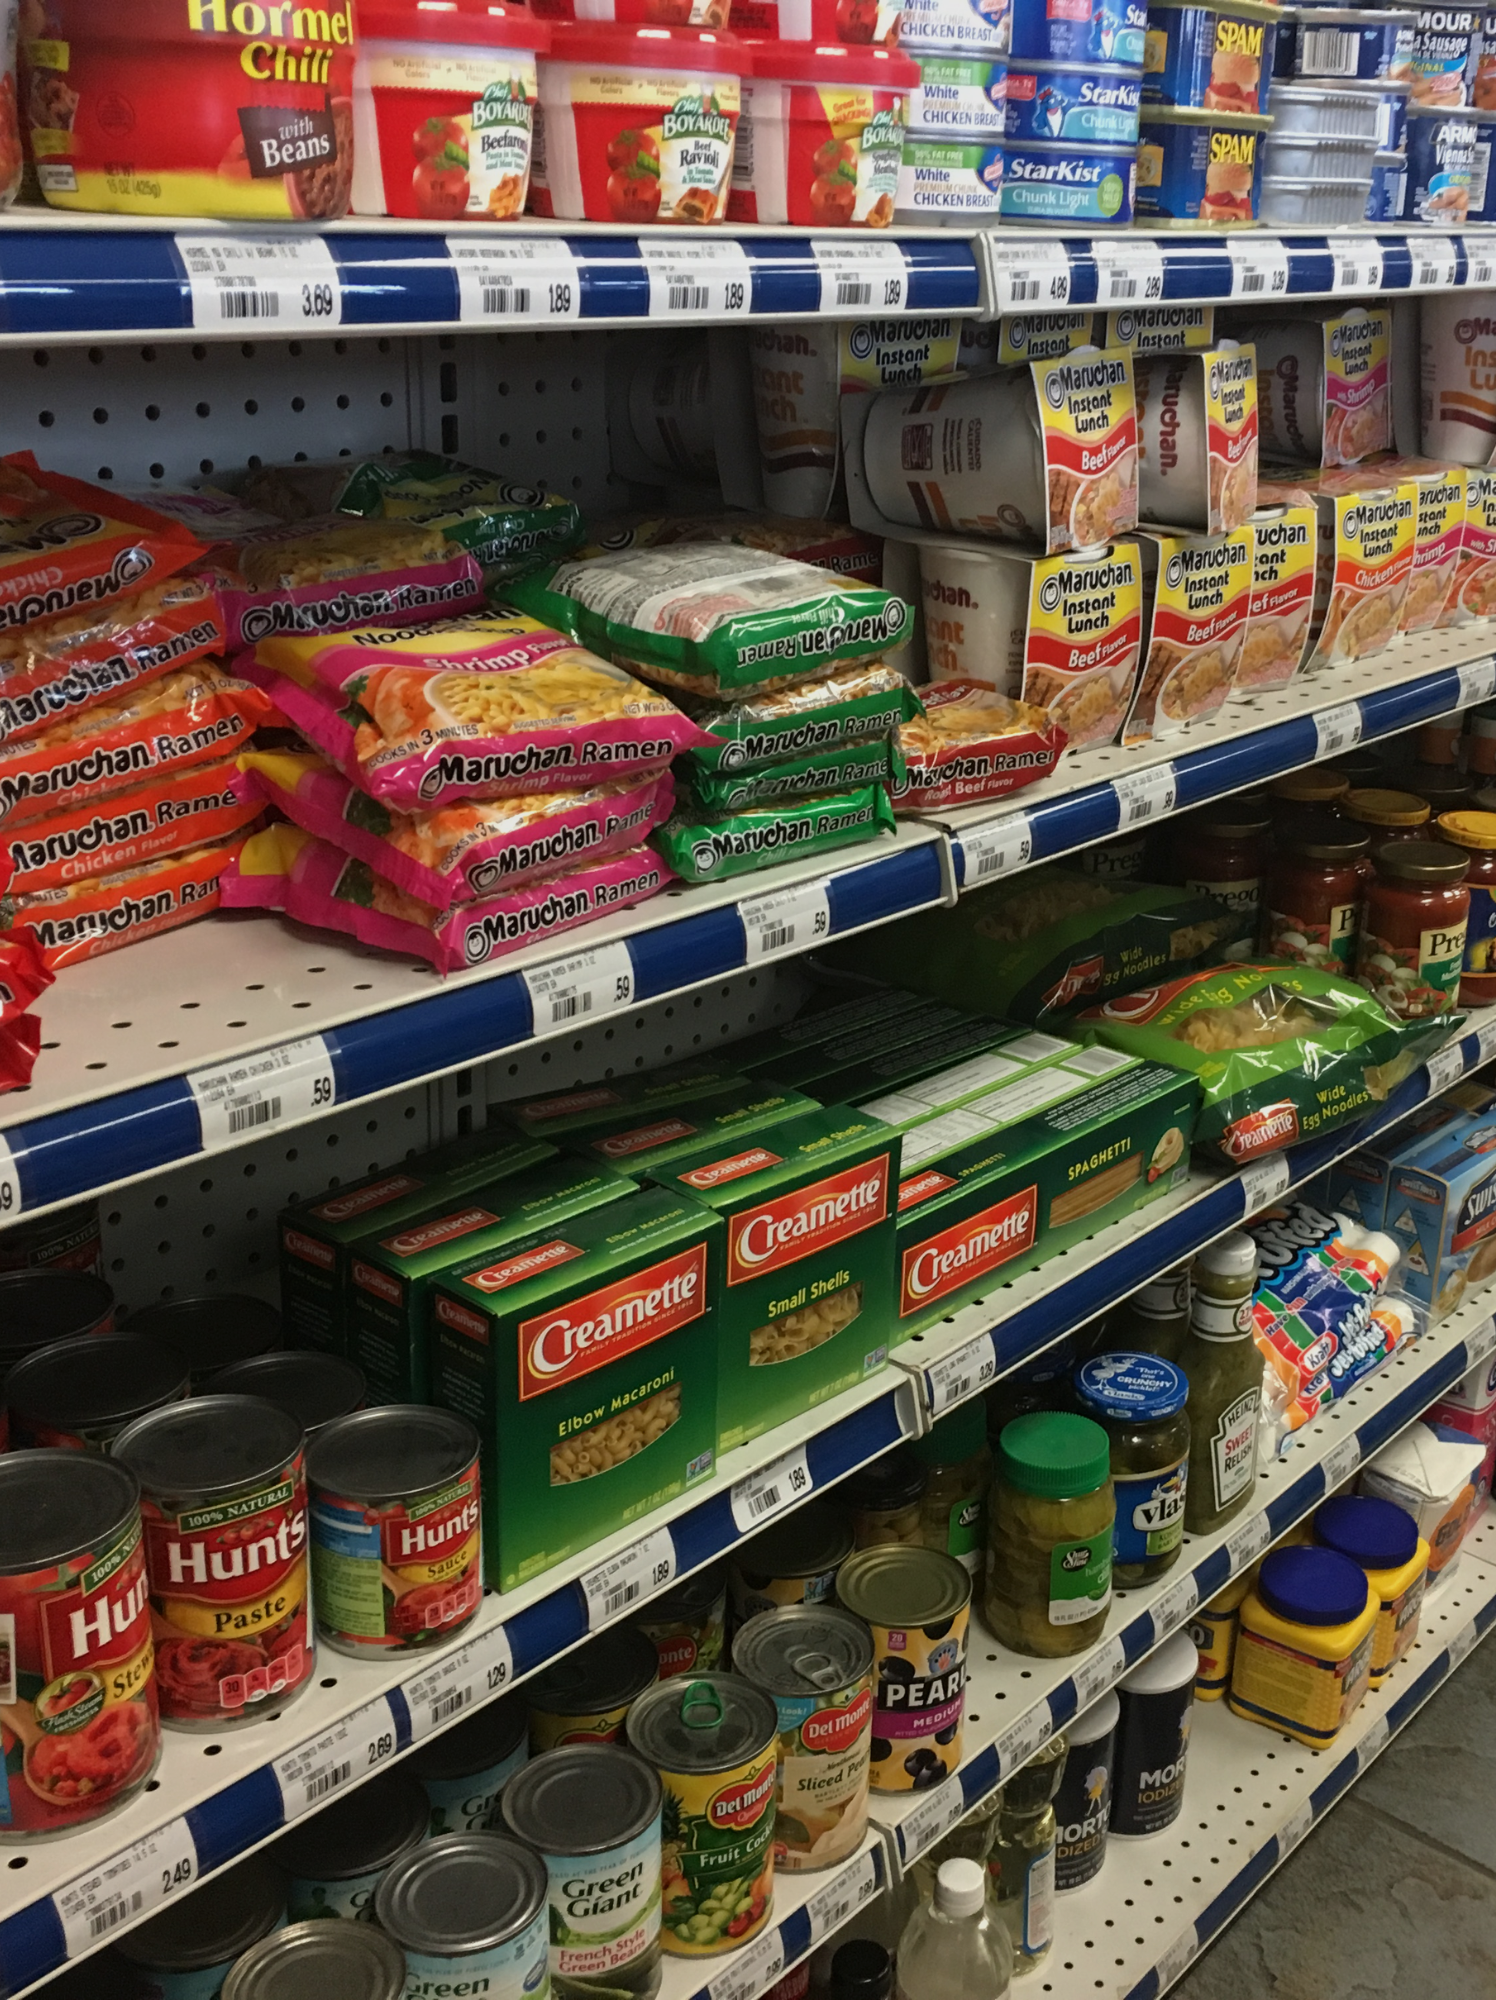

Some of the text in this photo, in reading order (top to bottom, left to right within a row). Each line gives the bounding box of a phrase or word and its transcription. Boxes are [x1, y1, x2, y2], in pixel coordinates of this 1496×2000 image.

[187, 0, 354, 45] Hormel
[900, 22, 992, 41] CHICKEN BREAST
[1216, 20, 1263, 57] SPAM
[1423, 33, 1468, 57] Sausage
[240, 41, 334, 84] Chili
[674, 98, 699, 114] Chef
[924, 85, 959, 100] White
[278, 116, 314, 141] with
[664, 113, 730, 141] BOYARDEE
[923, 110, 1000, 126] CHICKEN BREAST
[260, 134, 331, 169] Beans
[680, 149, 719, 168] Ravioli
[694, 140, 711, 151] Beef
[1209, 131, 1255, 165] SPAM
[914, 168, 950, 182] White
[1009, 158, 1102, 183] StarKist
[914, 182, 977, 194] PREMIUM CHUNK
[914, 192, 994, 208] CHICKEN BREAST
[1012, 187, 1089, 207] Chunk Light
[302, 284, 333, 317] 3.69
[1136, 307, 1203, 328] Maruchan
[1339, 319, 1384, 344] Maruchan
[1027, 335, 1070, 355] Instant
[1137, 331, 1186, 348] Instant
[1342, 342, 1373, 362] Instant
[875, 347, 931, 367] Instant
[1345, 359, 1369, 376] Lunch
[881, 364, 922, 384] Lunch
[1061, 360, 1126, 391] Maruchan
[1068, 395, 1112, 416] Instant
[1220, 386, 1246, 407] Instant
[1075, 413, 1109, 433] Lunch
[1224, 406, 1244, 424] Lunch
[1081, 436, 1126, 471] Beef Flavor
[1357, 498, 1412, 526] Maruchan
[1360, 523, 1399, 543] Instant
[1181, 542, 1248, 572] Maruchan
[1363, 539, 1393, 558] Lunch
[1058, 562, 1137, 595] Maruchan
[1184, 571, 1230, 592] Instant
[1355, 553, 1413, 589] Chicken Flavor
[1063, 592, 1116, 617] Instant
[1188, 592, 1224, 611] Lunch
[1270, 586, 1298, 605] Flavor
[1067, 611, 1110, 634] Lunch
[1186, 610, 1238, 643] Beef Flavor
[140, 620, 219, 671] Ramen
[736, 621, 888, 668] Maruchan Ramen
[368, 724, 480, 768] COOKS IN 3 MINUTES
[440, 738, 674, 784] Maruchan Ramen
[488, 770, 593, 793] Shrimp Flavor
[955, 773, 985, 795] Beef
[987, 775, 1014, 789] Flavor
[1017, 839, 1031, 863] .59
[812, 911, 827, 936] .59
[1120, 949, 1144, 963] Wide
[1122, 954, 1167, 979] Noodles
[613, 976, 631, 1002] .59
[311, 1077, 331, 1107] .59
[1316, 1084, 1347, 1104] Wide
[715, 1095, 786, 1125] Small Shells
[1303, 1090, 1370, 1131] Egg Noodles
[799, 1123, 867, 1153] Small Shells
[1067, 1136, 1132, 1182] SPAGHETTI
[521, 1177, 601, 1212] Elbow Macaroni
[606, 1208, 685, 1244] Elbow Macaroni
[740, 1177, 881, 1263] Creamette
[779, 1203, 877, 1251] FAMILY TRADITION SINCE 1912
[911, 1208, 1030, 1300] Creamette
[532, 1272, 698, 1374] Creamette
[579, 1297, 694, 1358] FAMILY TRADITION SINCE 1912
[1265, 1296, 1308, 1337] Have Fun
[1308, 1341, 1338, 1370] Kraft
[1117, 1375, 1174, 1390] CRUNCHY
[558, 1368, 676, 1438] Elbow Macaroni
[1228, 1396, 1255, 1429] HEINZ
[1224, 1425, 1254, 1456] SWEET
[1224, 1444, 1252, 1474] RELISH
[188, 1486, 289, 1528] 100% NATURAL
[414, 1484, 470, 1517] 100% NATURAL
[401, 1499, 478, 1556] Hunt's
[167, 1509, 305, 1583] Hunt's
[427, 1549, 468, 1579] Sauce
[214, 1596, 287, 1634] Paste
[891, 1633, 903, 1643] 20
[224, 1680, 240, 1694] 30
[53, 1705, 100, 1733] FRESHNESS
[808, 1702, 870, 1739] Del Monte
[912, 1699, 962, 1730] MEDIUM
[796, 1768, 844, 1792] Sliced
[715, 1772, 775, 1818] Del Monte
[699, 1848, 740, 1868] Fruit
[162, 1857, 192, 1895] 2.49
[562, 1862, 644, 1899] Green
[566, 1888, 642, 1919] Giant
[558, 1938, 647, 1975] Green Beans
[559, 1927, 646, 1964] French Style
[405, 1972, 490, 1999] Green
